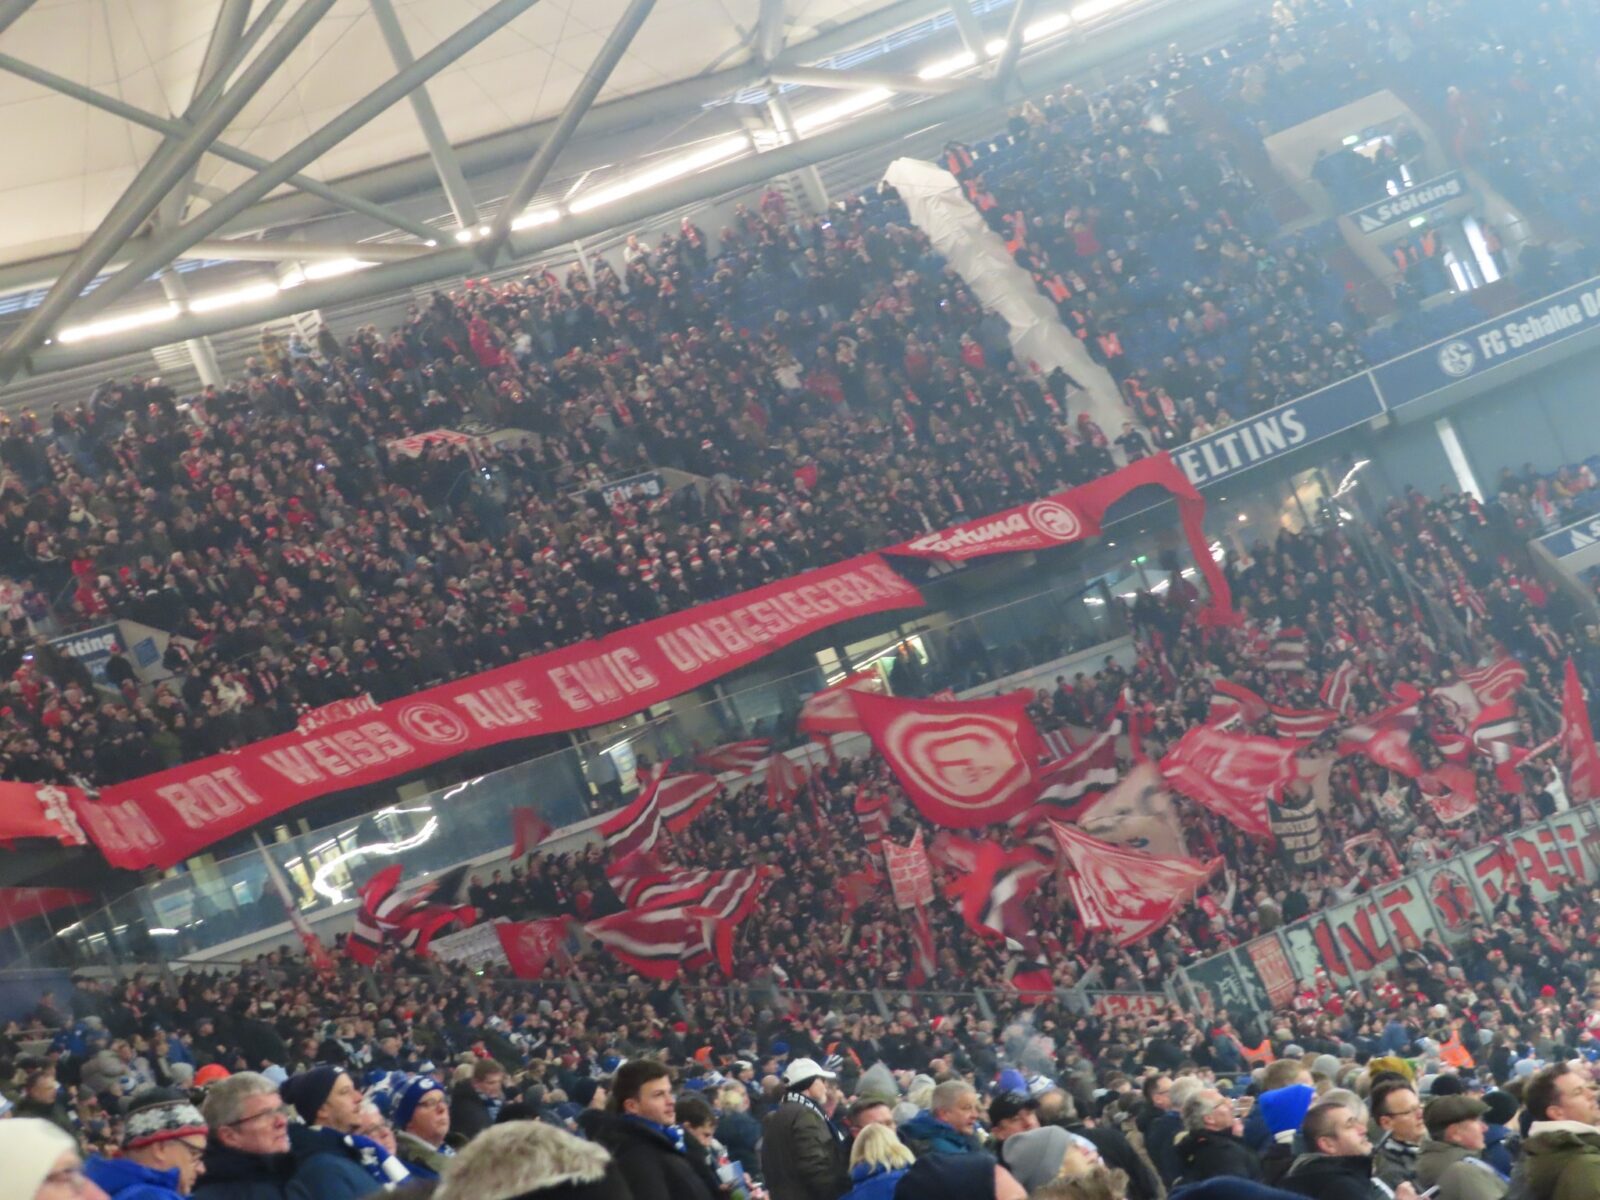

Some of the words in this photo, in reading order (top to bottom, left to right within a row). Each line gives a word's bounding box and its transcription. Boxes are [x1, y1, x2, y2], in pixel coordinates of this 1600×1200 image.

[1377, 179, 1460, 221] Stölting
[1478, 329, 1507, 360] FC
[1504, 303, 1583, 349] Schalke
[1171, 408, 1306, 486] ELTINS
[908, 513, 1031, 553] Fortuna
[155, 766, 263, 829] ROT
[260, 721, 415, 786] WEISS
[454, 680, 542, 730] AUF
[547, 648, 658, 712] EWIG
[655, 563, 908, 672] UNBESIEGBAR
